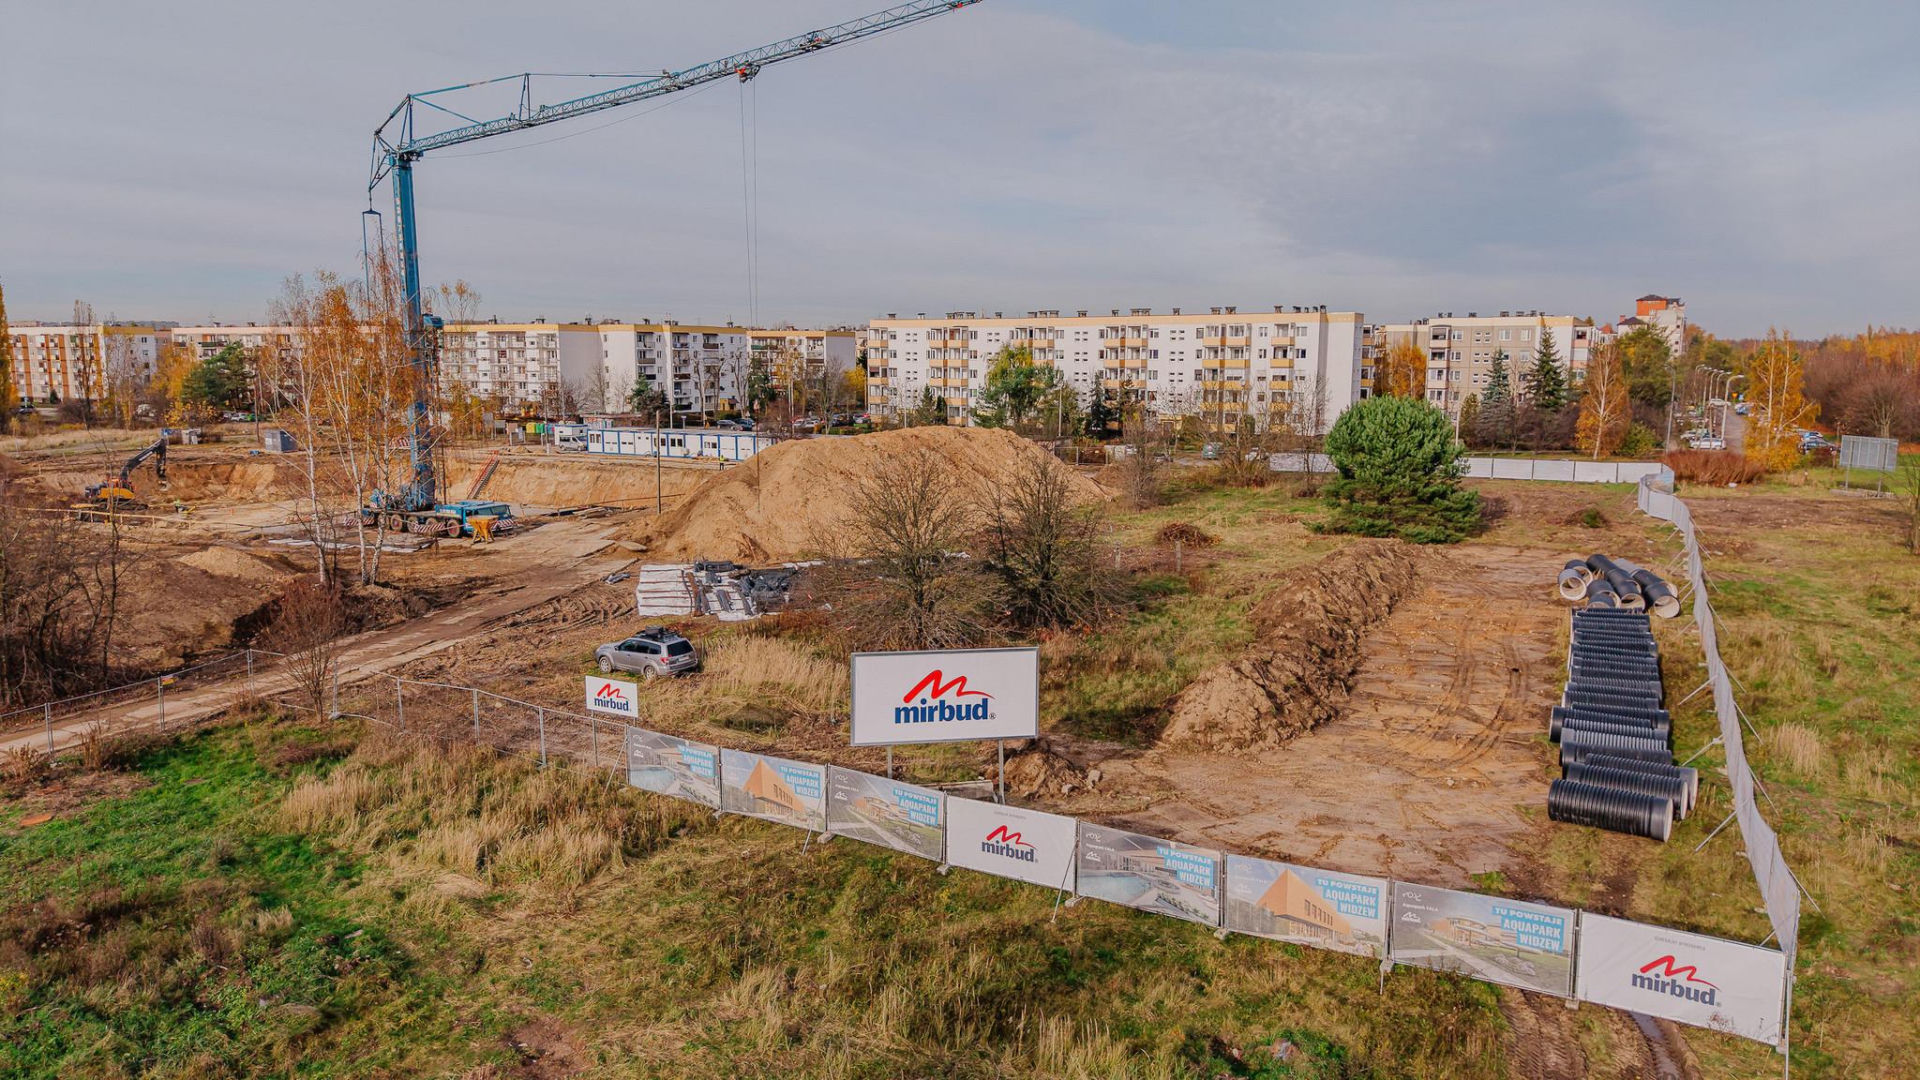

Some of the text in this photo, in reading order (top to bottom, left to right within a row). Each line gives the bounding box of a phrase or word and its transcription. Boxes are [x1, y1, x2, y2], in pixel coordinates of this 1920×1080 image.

[594, 696, 629, 711] mirbud
[894, 697, 989, 724] mirbud
[900, 799, 937, 814] AQUAPARK
[981, 840, 1035, 862] mirbud
[1166, 858, 1210, 876] AQUAPARK
[1180, 871, 1210, 886] WIDZEW
[1317, 878, 1377, 894] TU POWSTAJE
[1325, 889, 1376, 906] AQUAPARK
[1340, 901, 1376, 917] WIDZEW
[1495, 907, 1562, 925] TU POWSTAJE
[1503, 919, 1561, 938] AQUAPARK
[1519, 933, 1560, 950] WIDZEW
[1631, 973, 1715, 1005] mirbud
